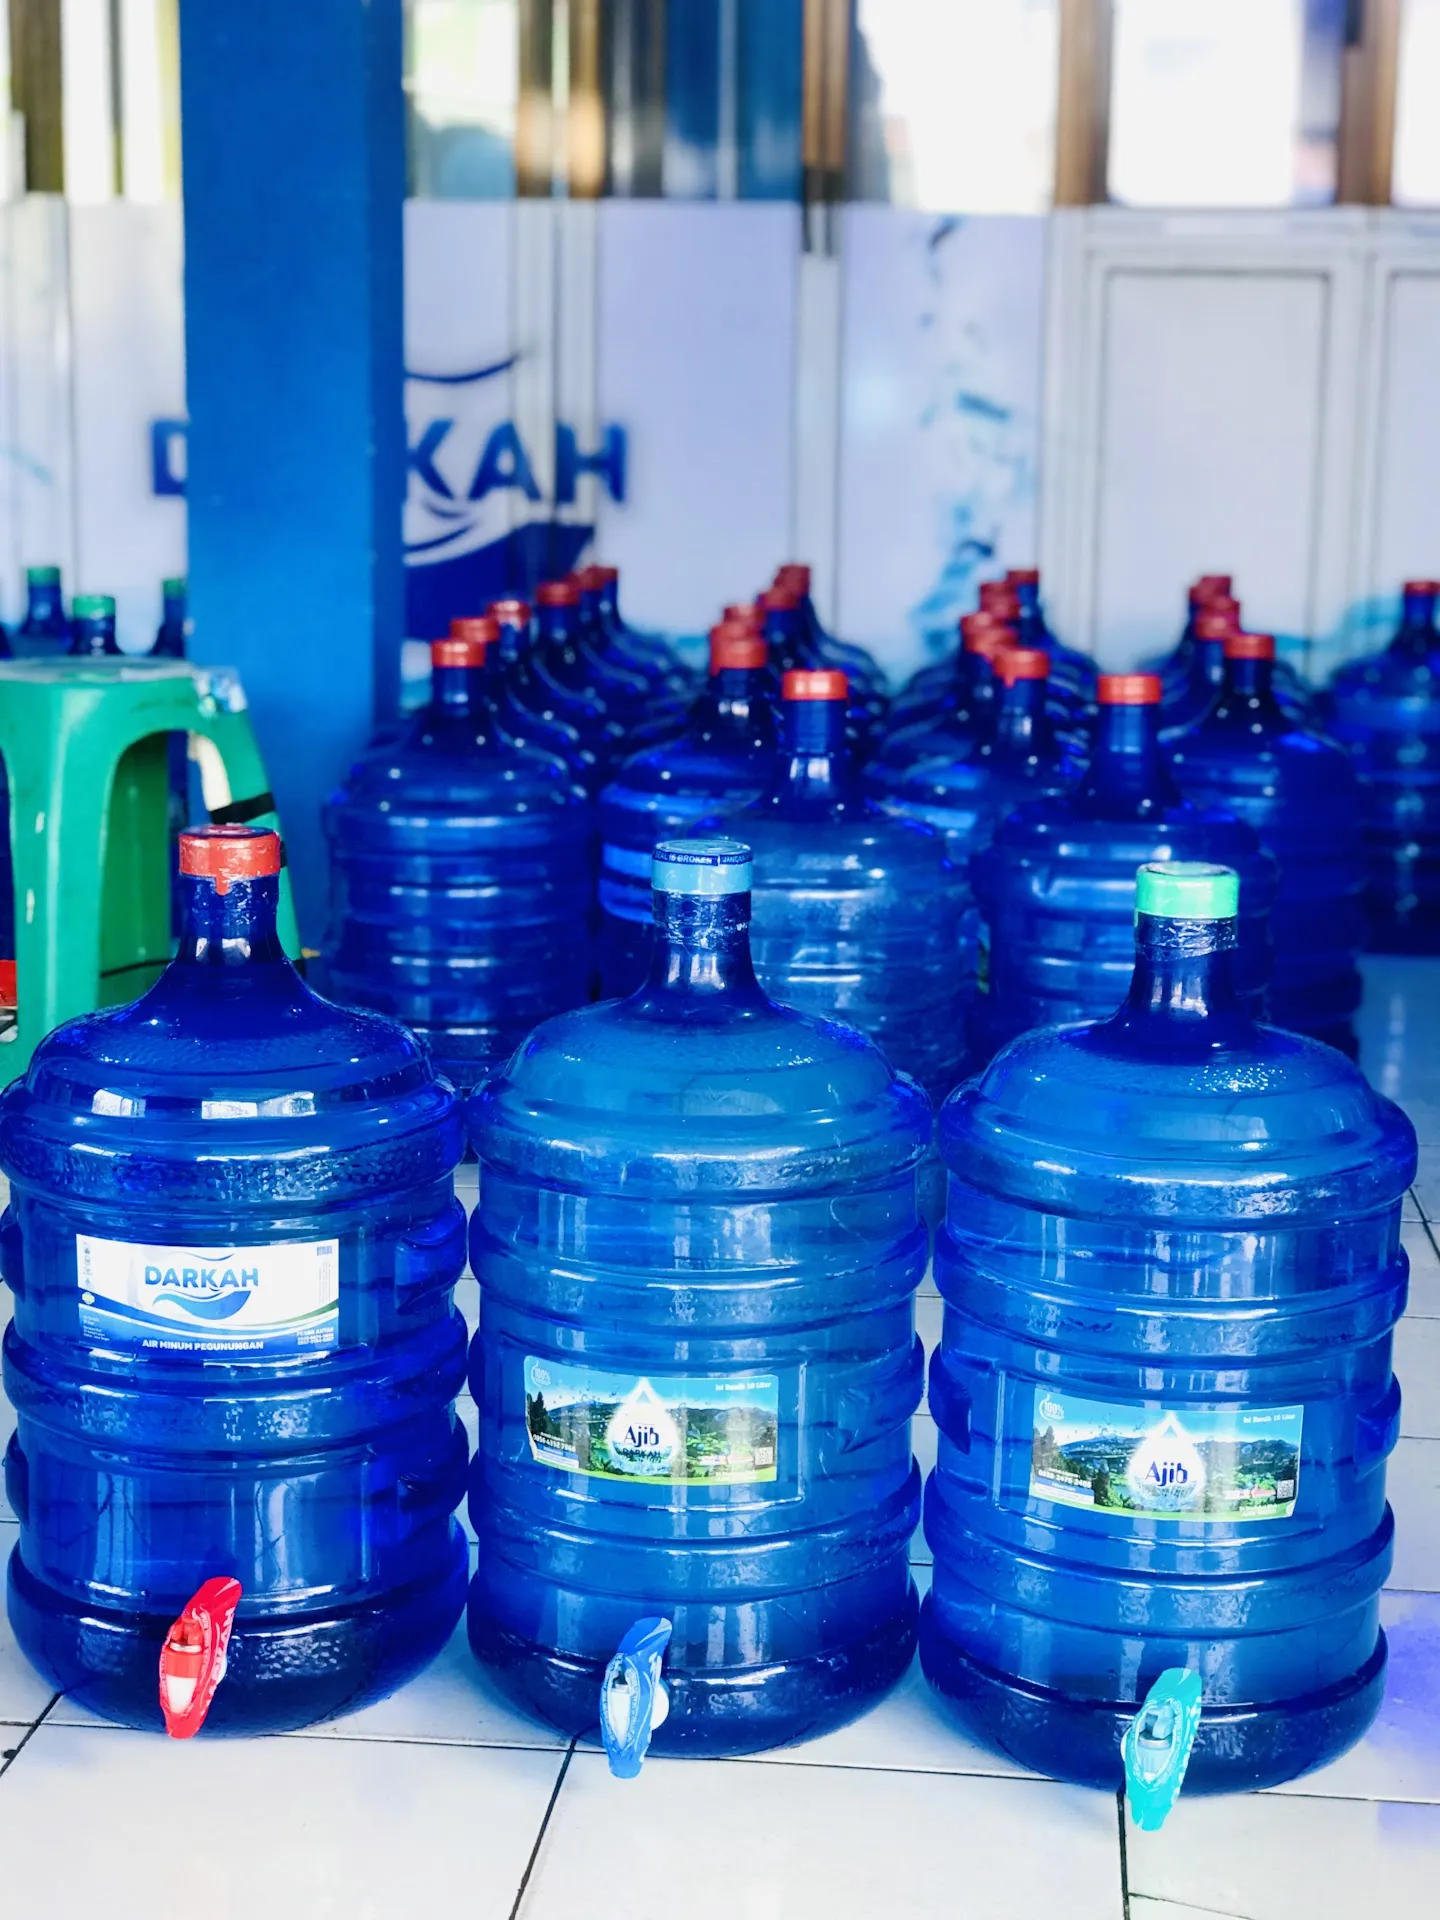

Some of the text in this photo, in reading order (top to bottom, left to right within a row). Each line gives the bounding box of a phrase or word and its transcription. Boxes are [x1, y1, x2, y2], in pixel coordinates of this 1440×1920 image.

[669, 854, 676, 862] IS
[677, 855, 713, 864] BROKEN
[144, 1265, 259, 1289] DARKAH
[142, 1339, 264, 1351] AIR MINUM PEGUNUNGAN
[624, 1425, 660, 1448] Ajib
[1144, 1460, 1188, 1487] Ajib
